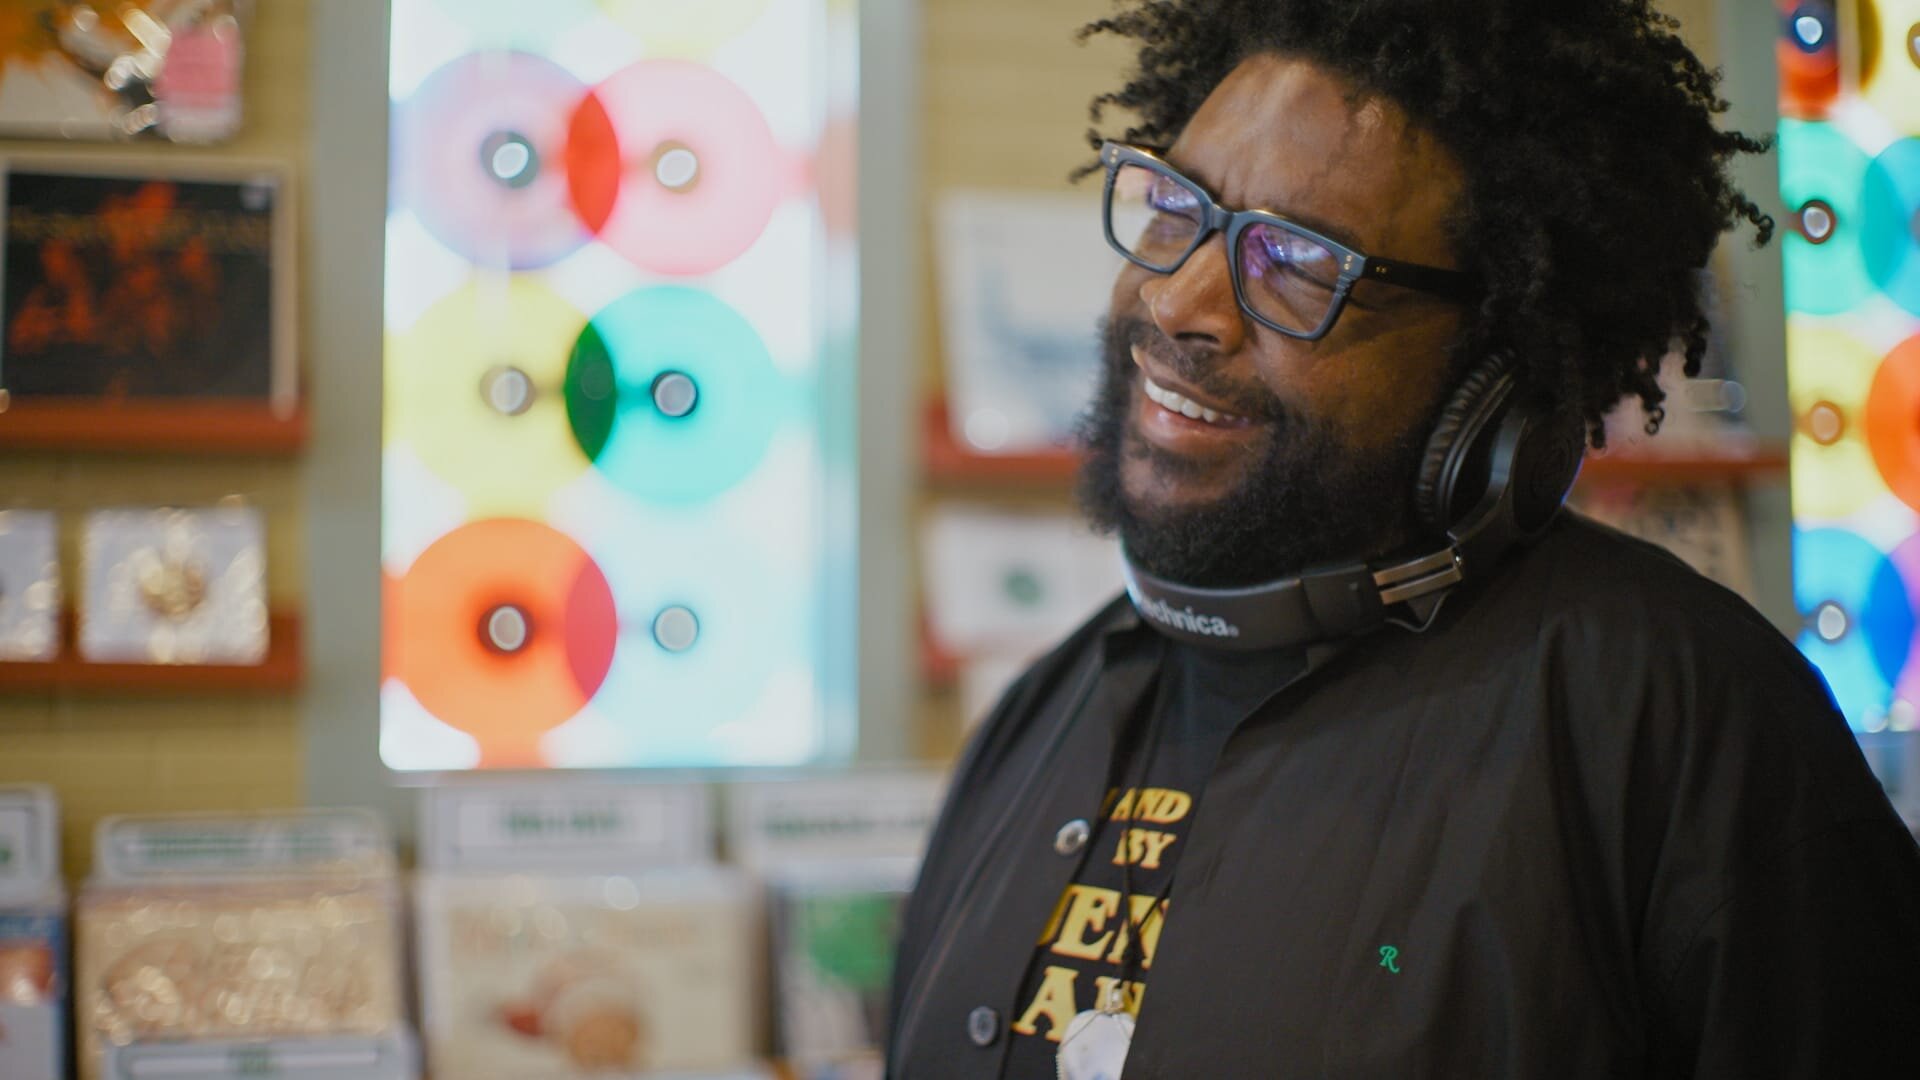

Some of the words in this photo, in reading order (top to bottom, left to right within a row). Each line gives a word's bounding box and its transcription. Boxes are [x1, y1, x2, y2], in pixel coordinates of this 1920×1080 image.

[1110, 787, 1192, 825] AND
[1111, 827, 1177, 870] BY
[1379, 945, 1400, 974] R
